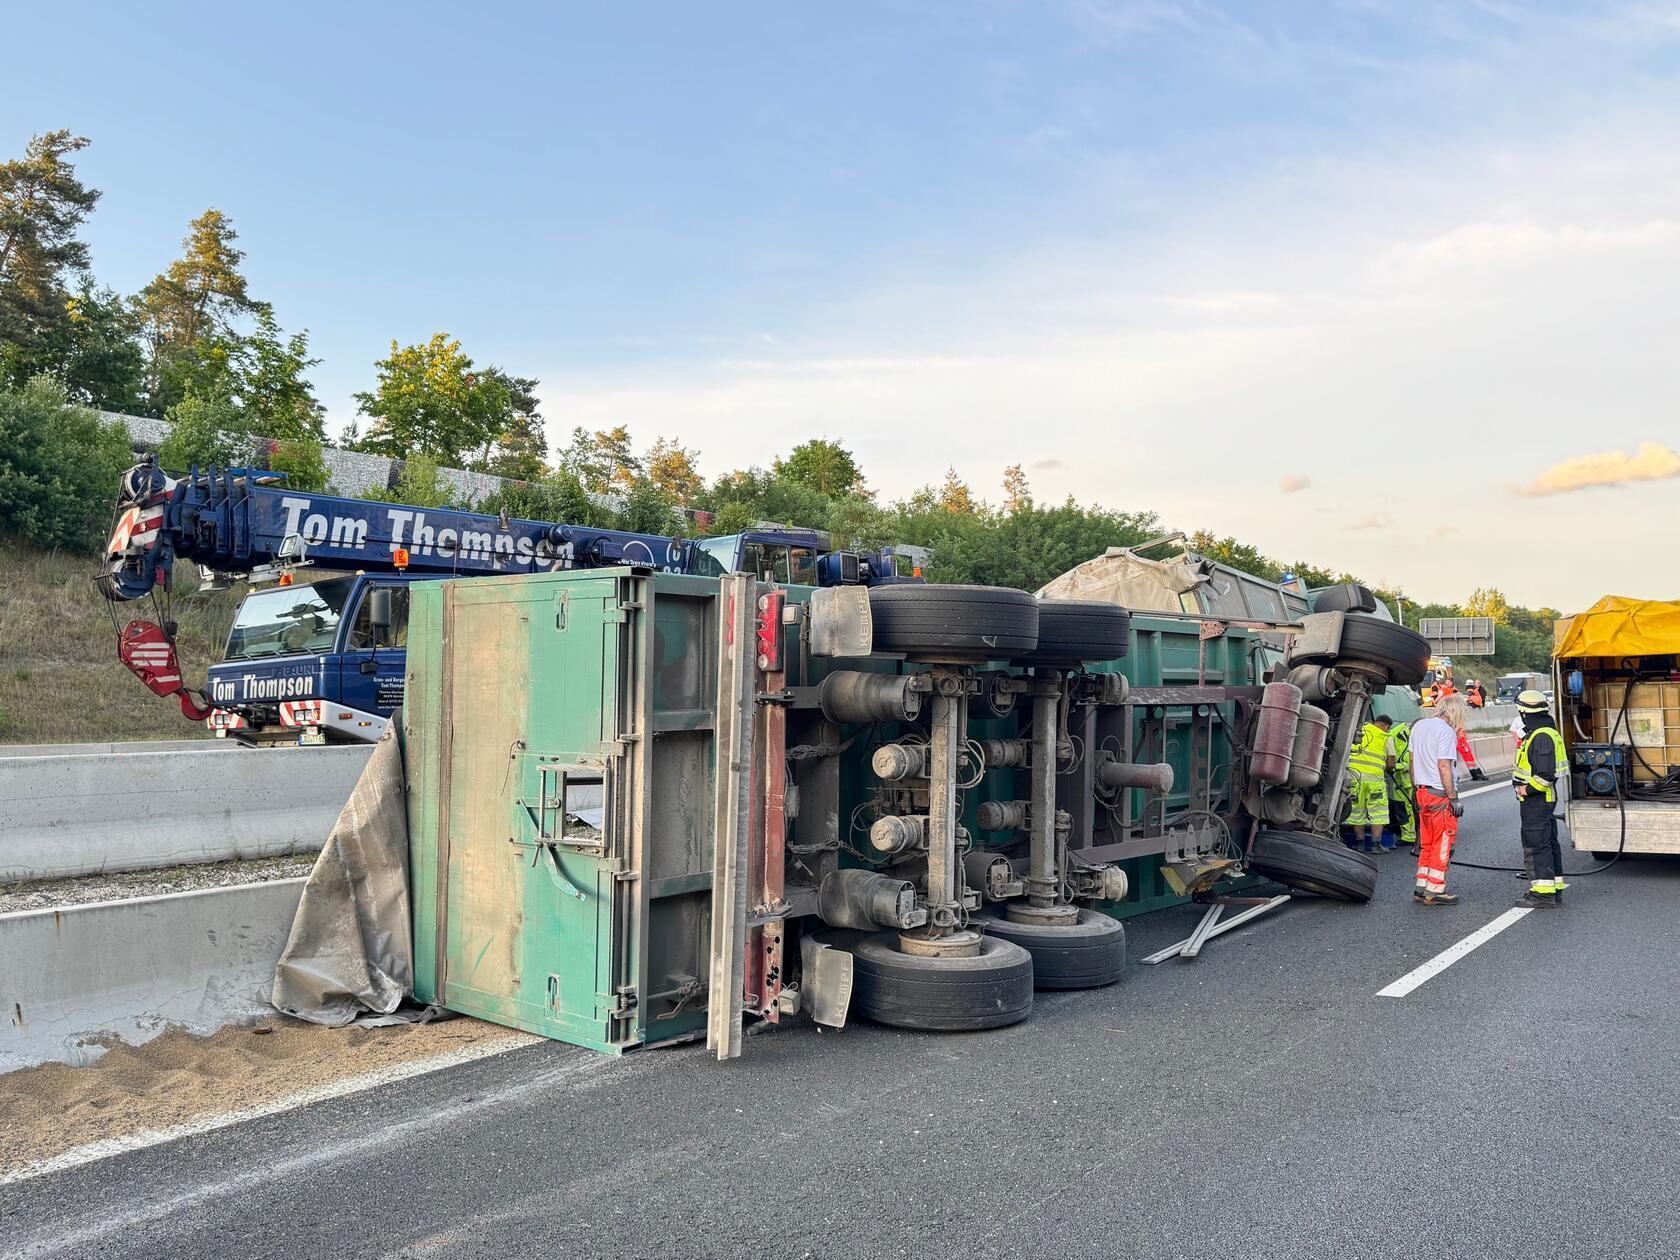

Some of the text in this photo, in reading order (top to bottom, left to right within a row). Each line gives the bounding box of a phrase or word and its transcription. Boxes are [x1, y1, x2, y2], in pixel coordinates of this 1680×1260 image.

[282, 497, 575, 569] Tom Thompson
[213, 674, 313, 701] Tom Thompson
